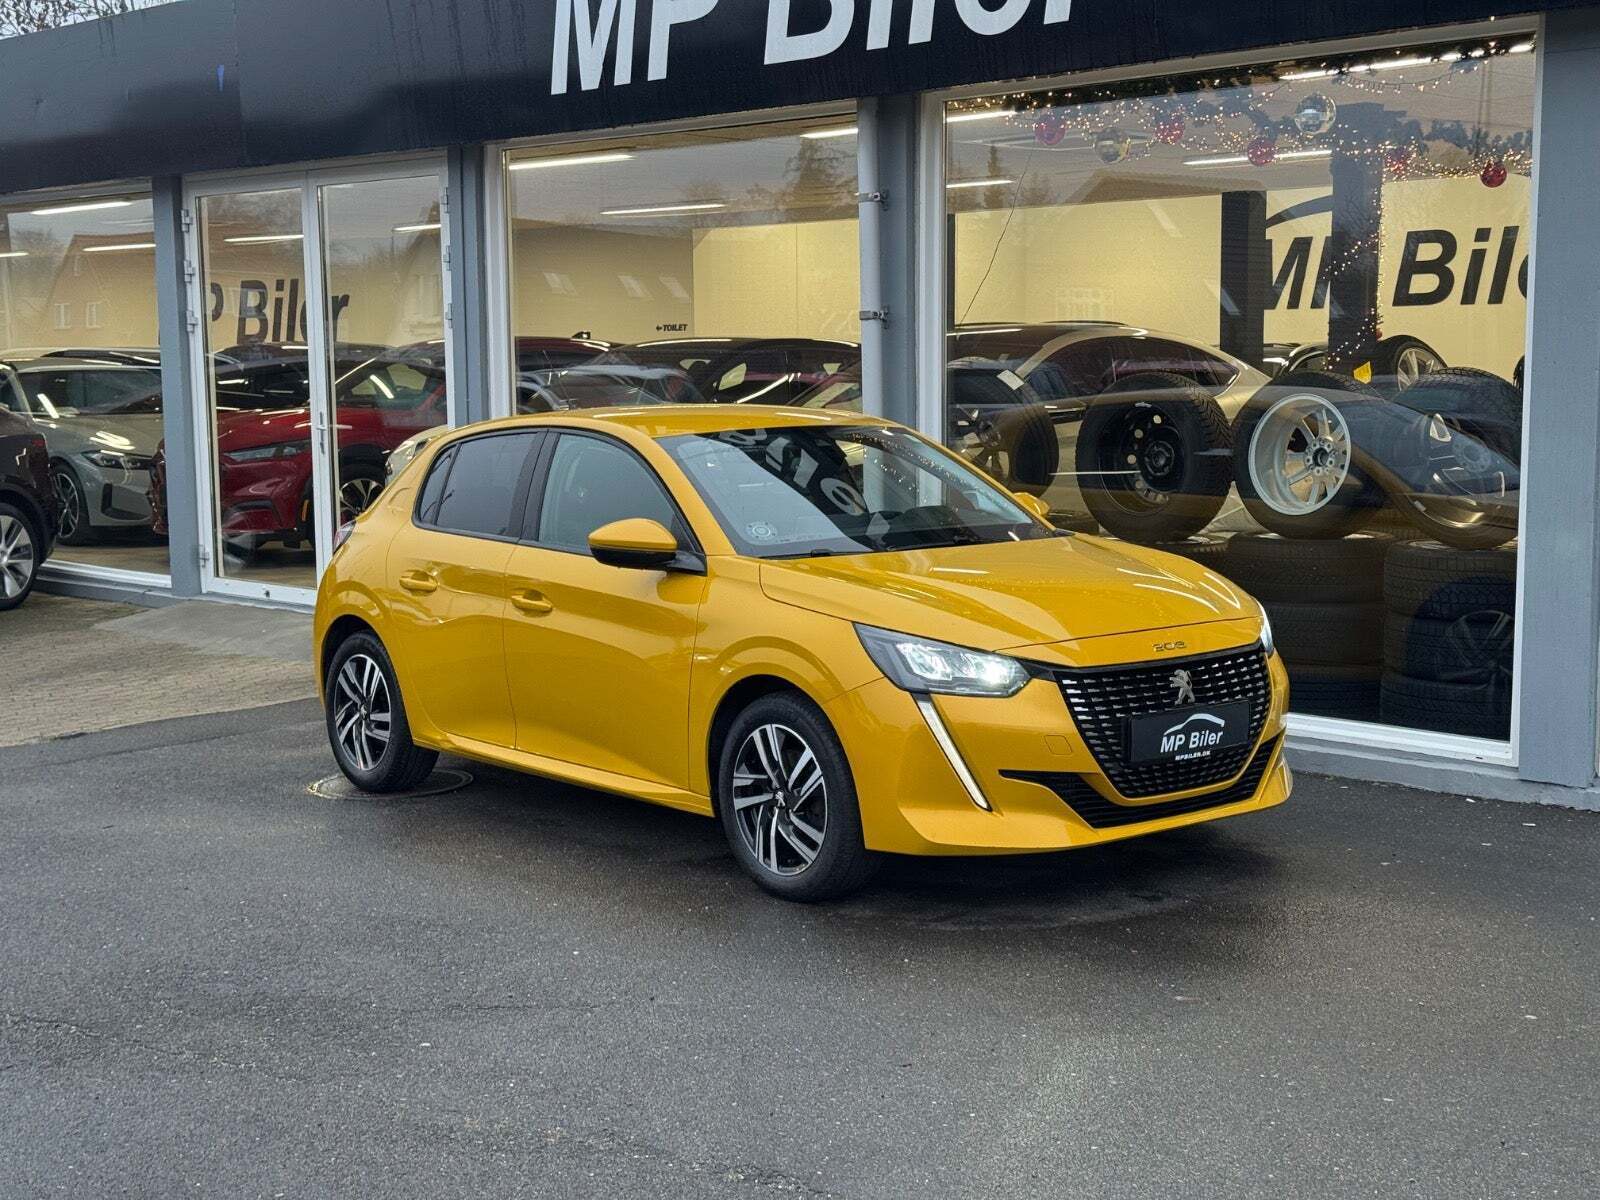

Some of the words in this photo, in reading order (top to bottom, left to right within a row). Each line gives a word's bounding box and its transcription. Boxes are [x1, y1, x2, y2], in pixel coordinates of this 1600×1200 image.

[1264, 235, 1332, 310] M
[236, 278, 350, 346] Bilr
[663, 323, 688, 331] TOILET
[1160, 735, 1186, 753] MP
[1189, 730, 1223, 749] Biler
